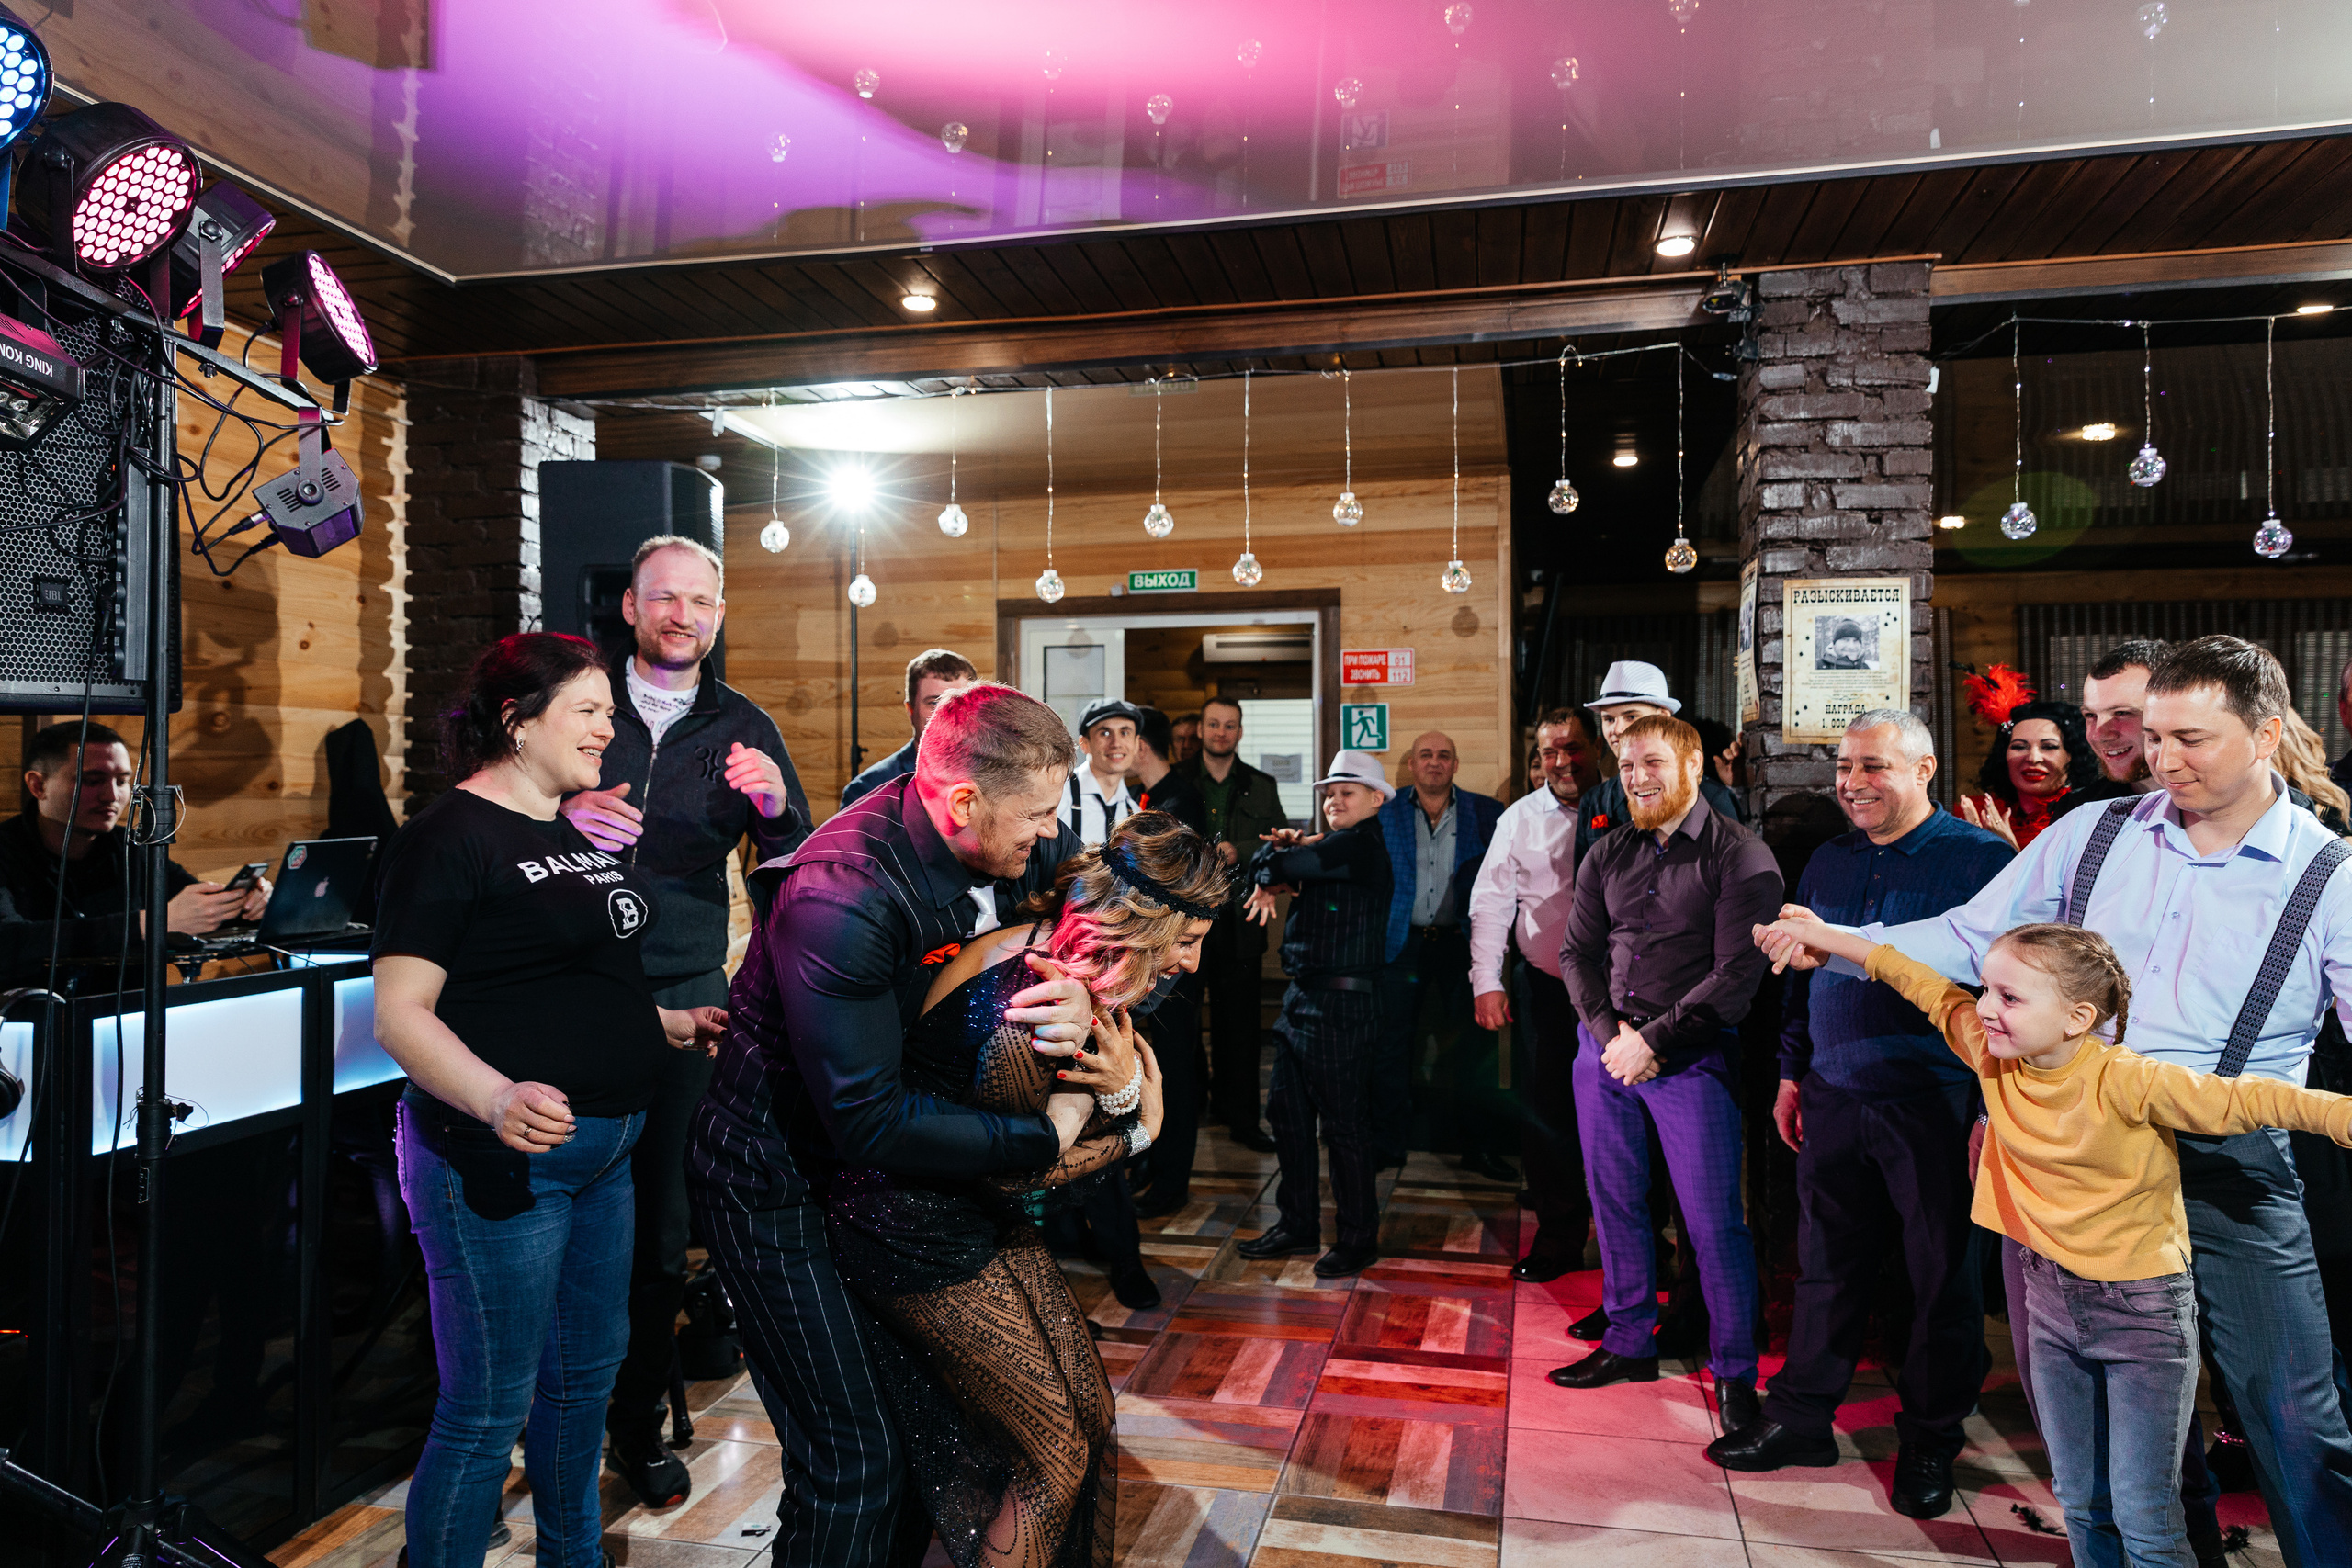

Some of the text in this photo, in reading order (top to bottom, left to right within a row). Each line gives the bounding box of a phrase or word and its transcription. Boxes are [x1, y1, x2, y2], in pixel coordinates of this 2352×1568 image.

[26, 355, 53, 378] KING
[1134, 573, 1191, 588] ВЫХОД
[45, 590, 63, 602] JBL
[1793, 588, 1900, 604] РАЗЫСКИВАЕТСЯ
[1344, 654, 1386, 666] ПРИ ПОЖАРЕ
[1395, 656, 1406, 666] 01
[1350, 669, 1381, 681] ЗВОНИТЬ
[1393, 672, 1408, 682] 112
[1826, 705, 1867, 714] НАГРАДА
[583, 870, 625, 886] PARIS
[616, 897, 639, 931] B
